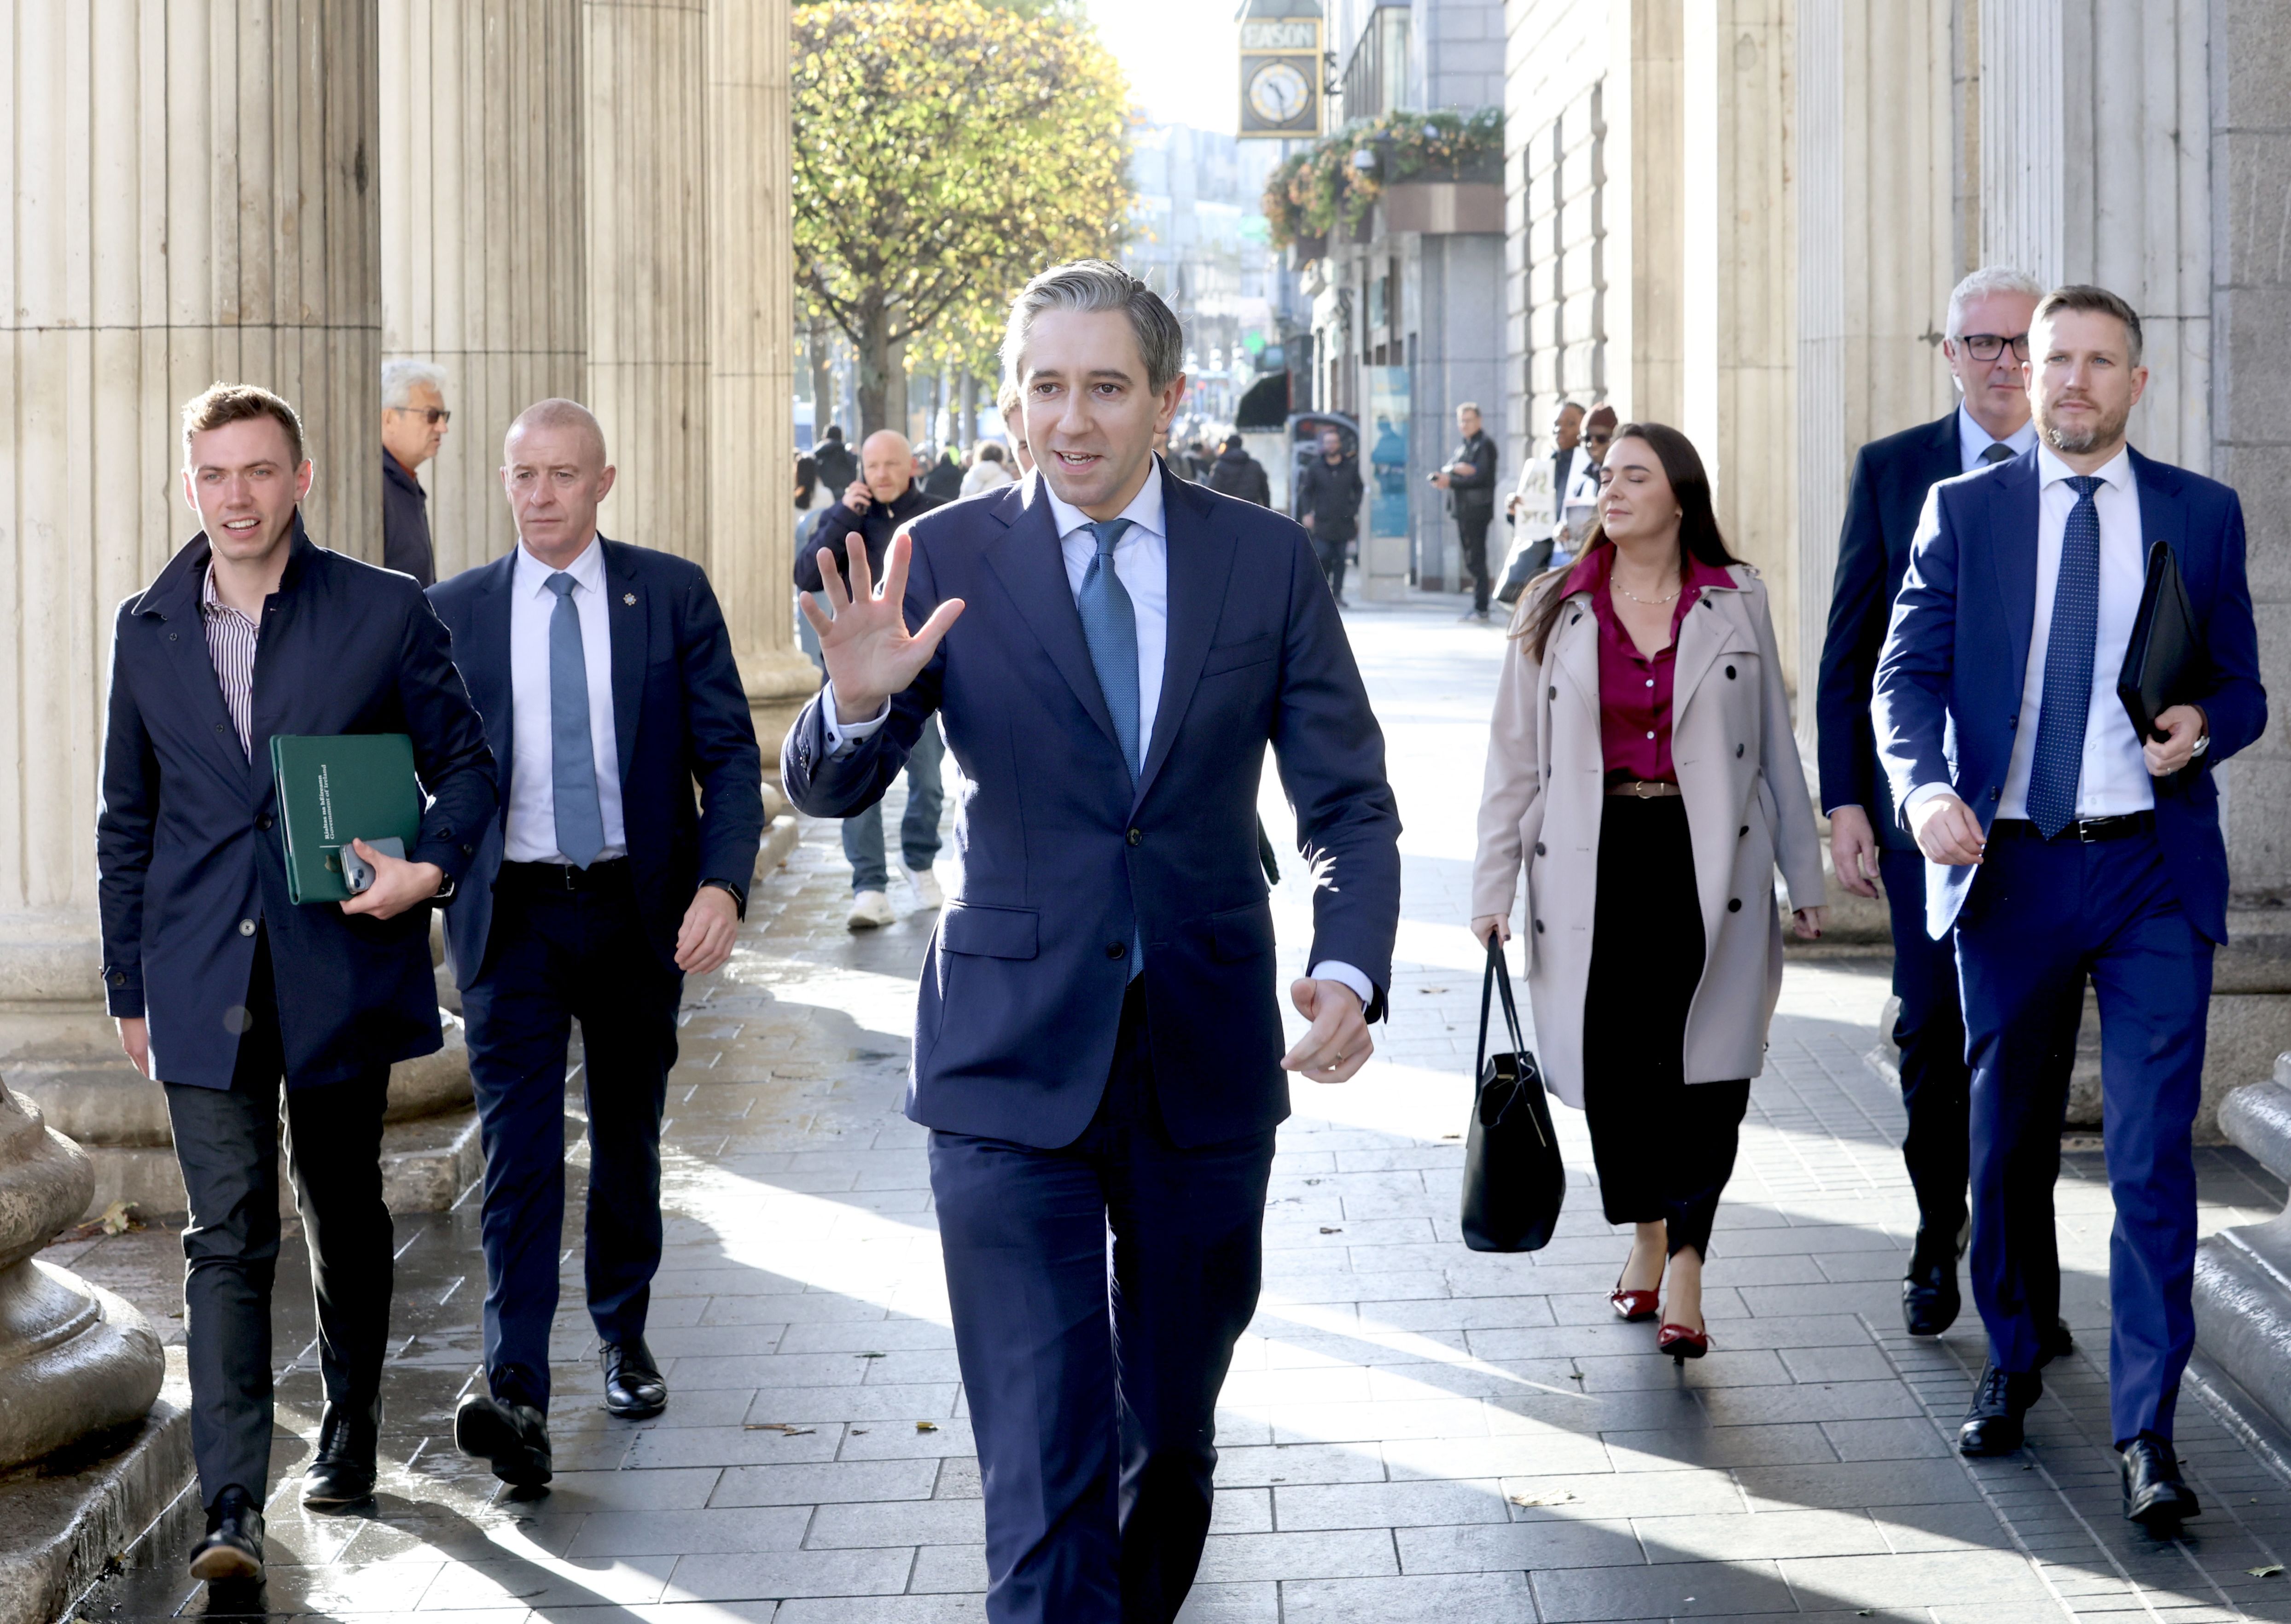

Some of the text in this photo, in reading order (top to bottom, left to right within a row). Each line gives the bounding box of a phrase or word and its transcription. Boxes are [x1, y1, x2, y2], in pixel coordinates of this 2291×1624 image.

[1244, 23, 1313, 47] EASON
[322, 806, 326, 815] na
[326, 797, 335, 839] Government
